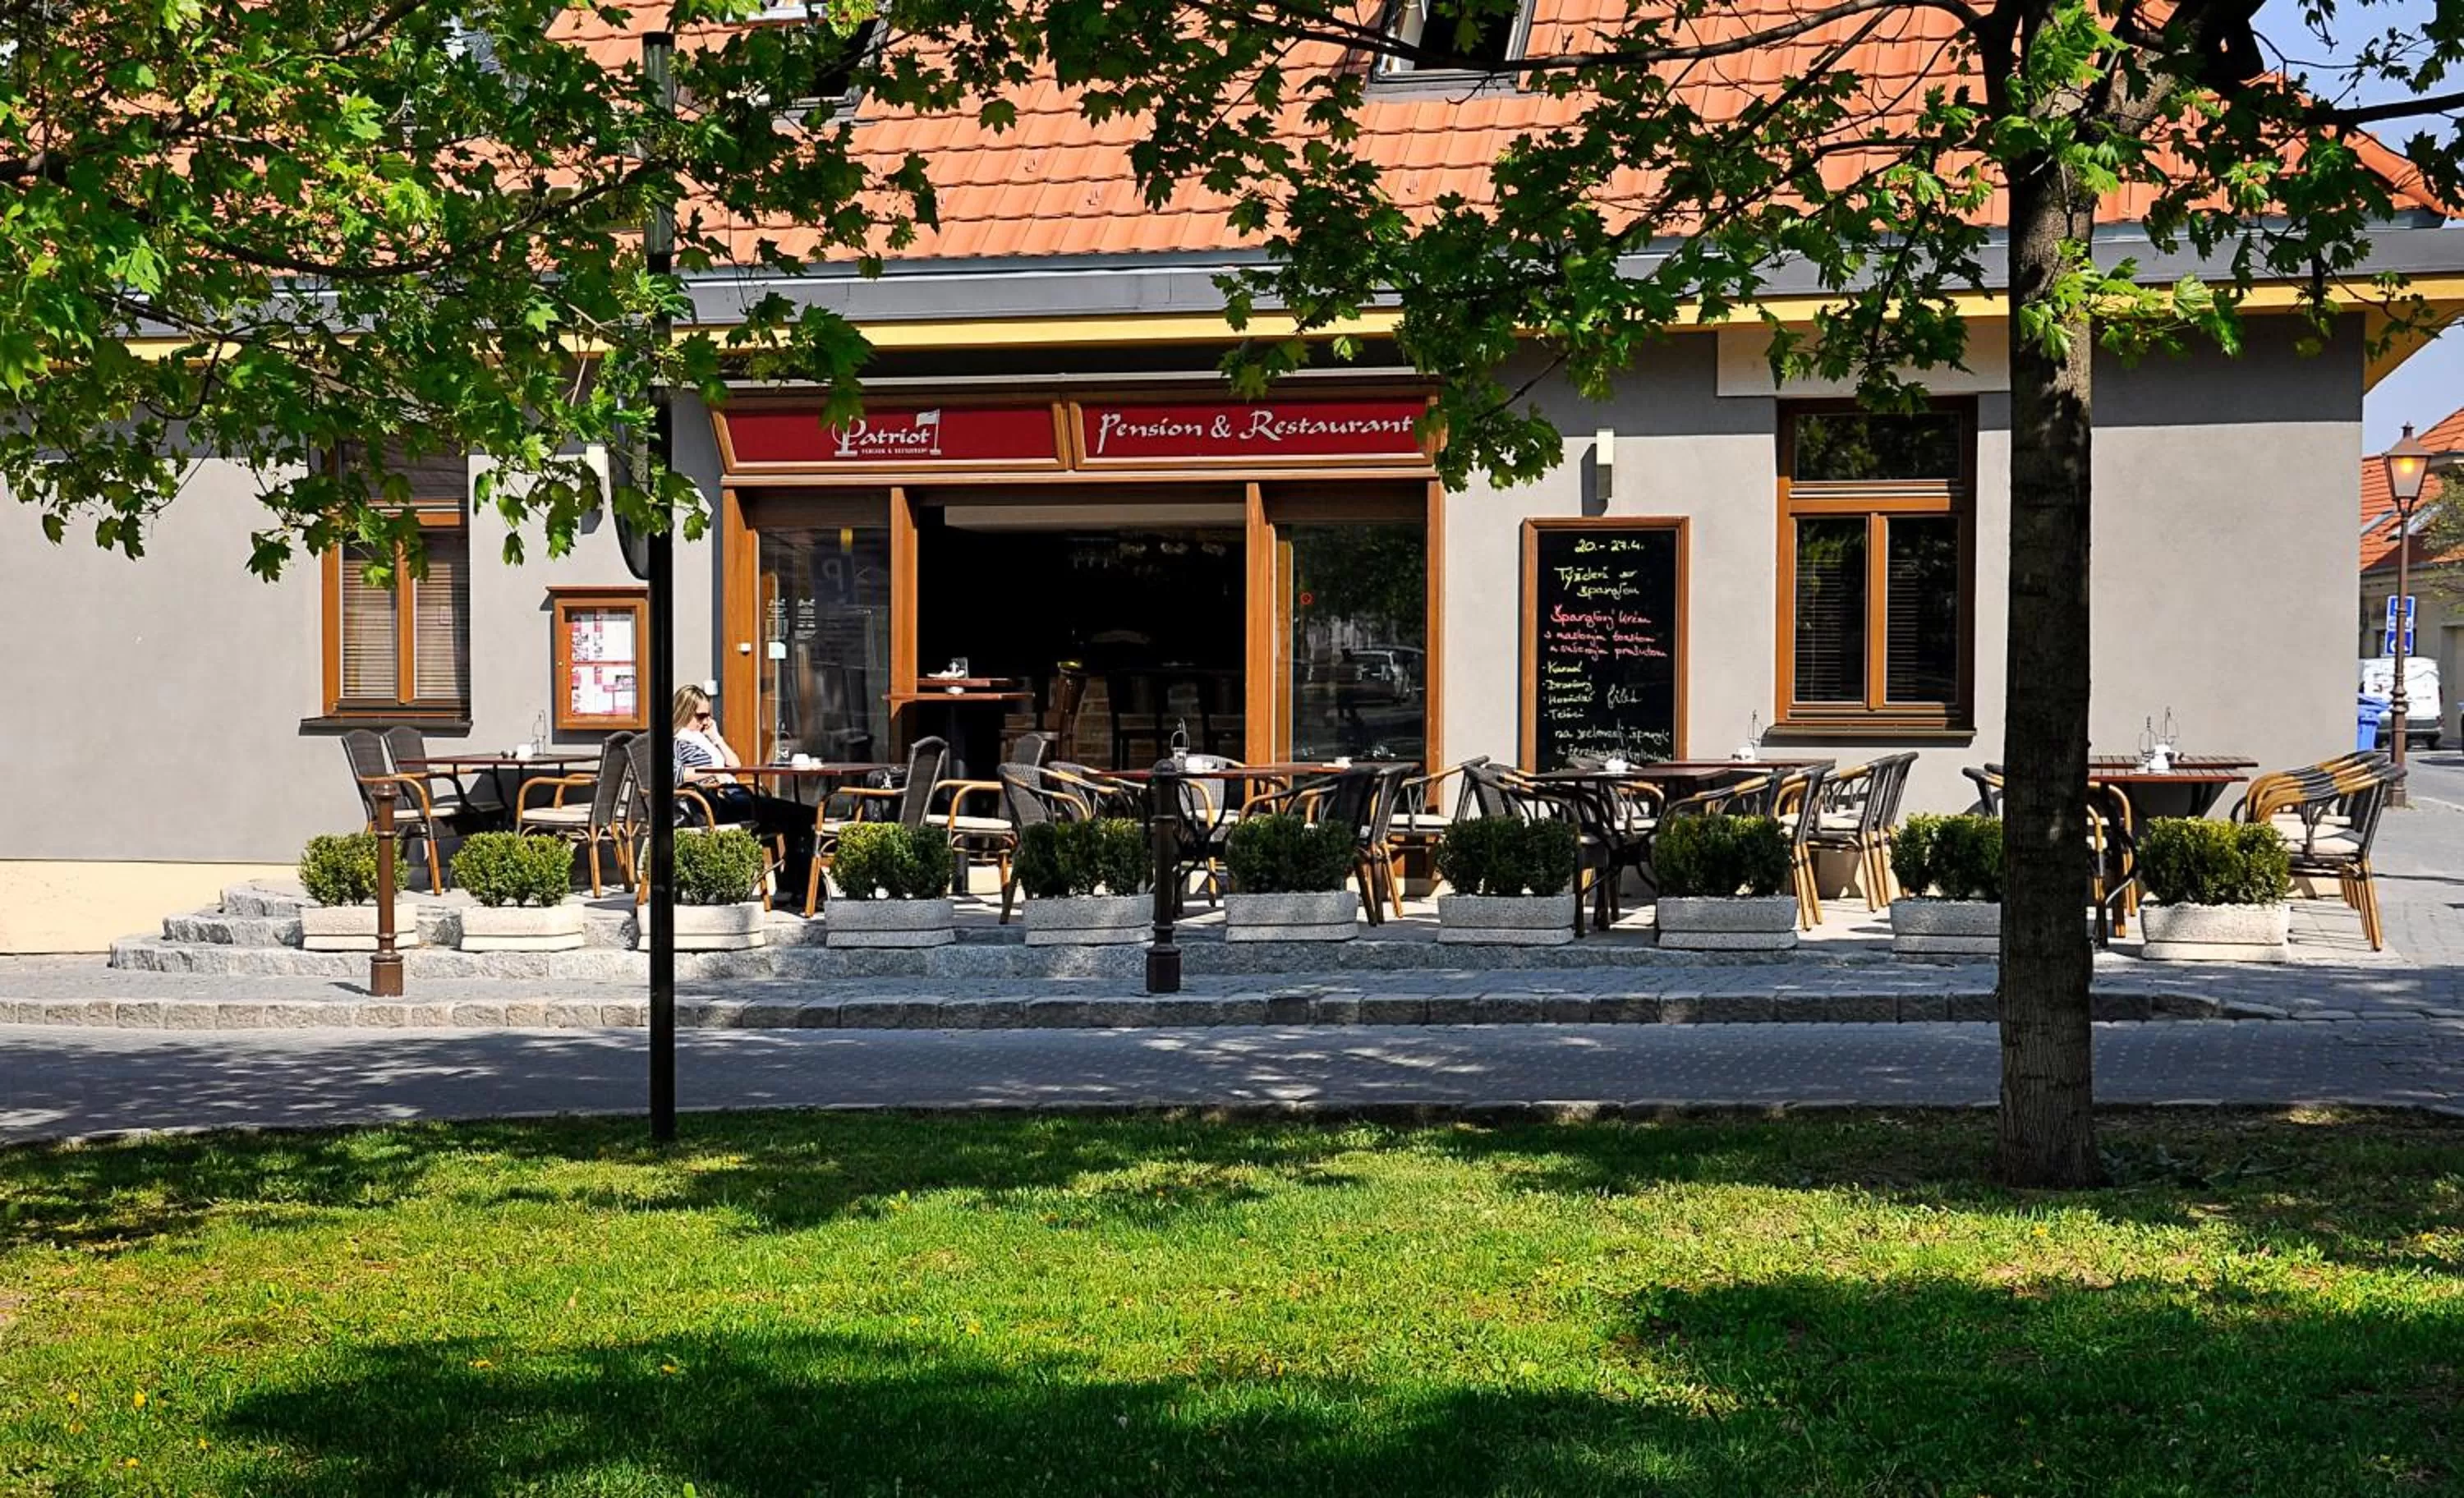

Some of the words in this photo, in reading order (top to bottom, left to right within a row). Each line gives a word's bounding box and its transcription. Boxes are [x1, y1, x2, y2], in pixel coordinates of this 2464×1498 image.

[831, 414, 930, 457] Patriot
[1097, 411, 1203, 455] Pension
[1210, 414, 1232, 439] &
[1239, 409, 1414, 442] Restaurant
